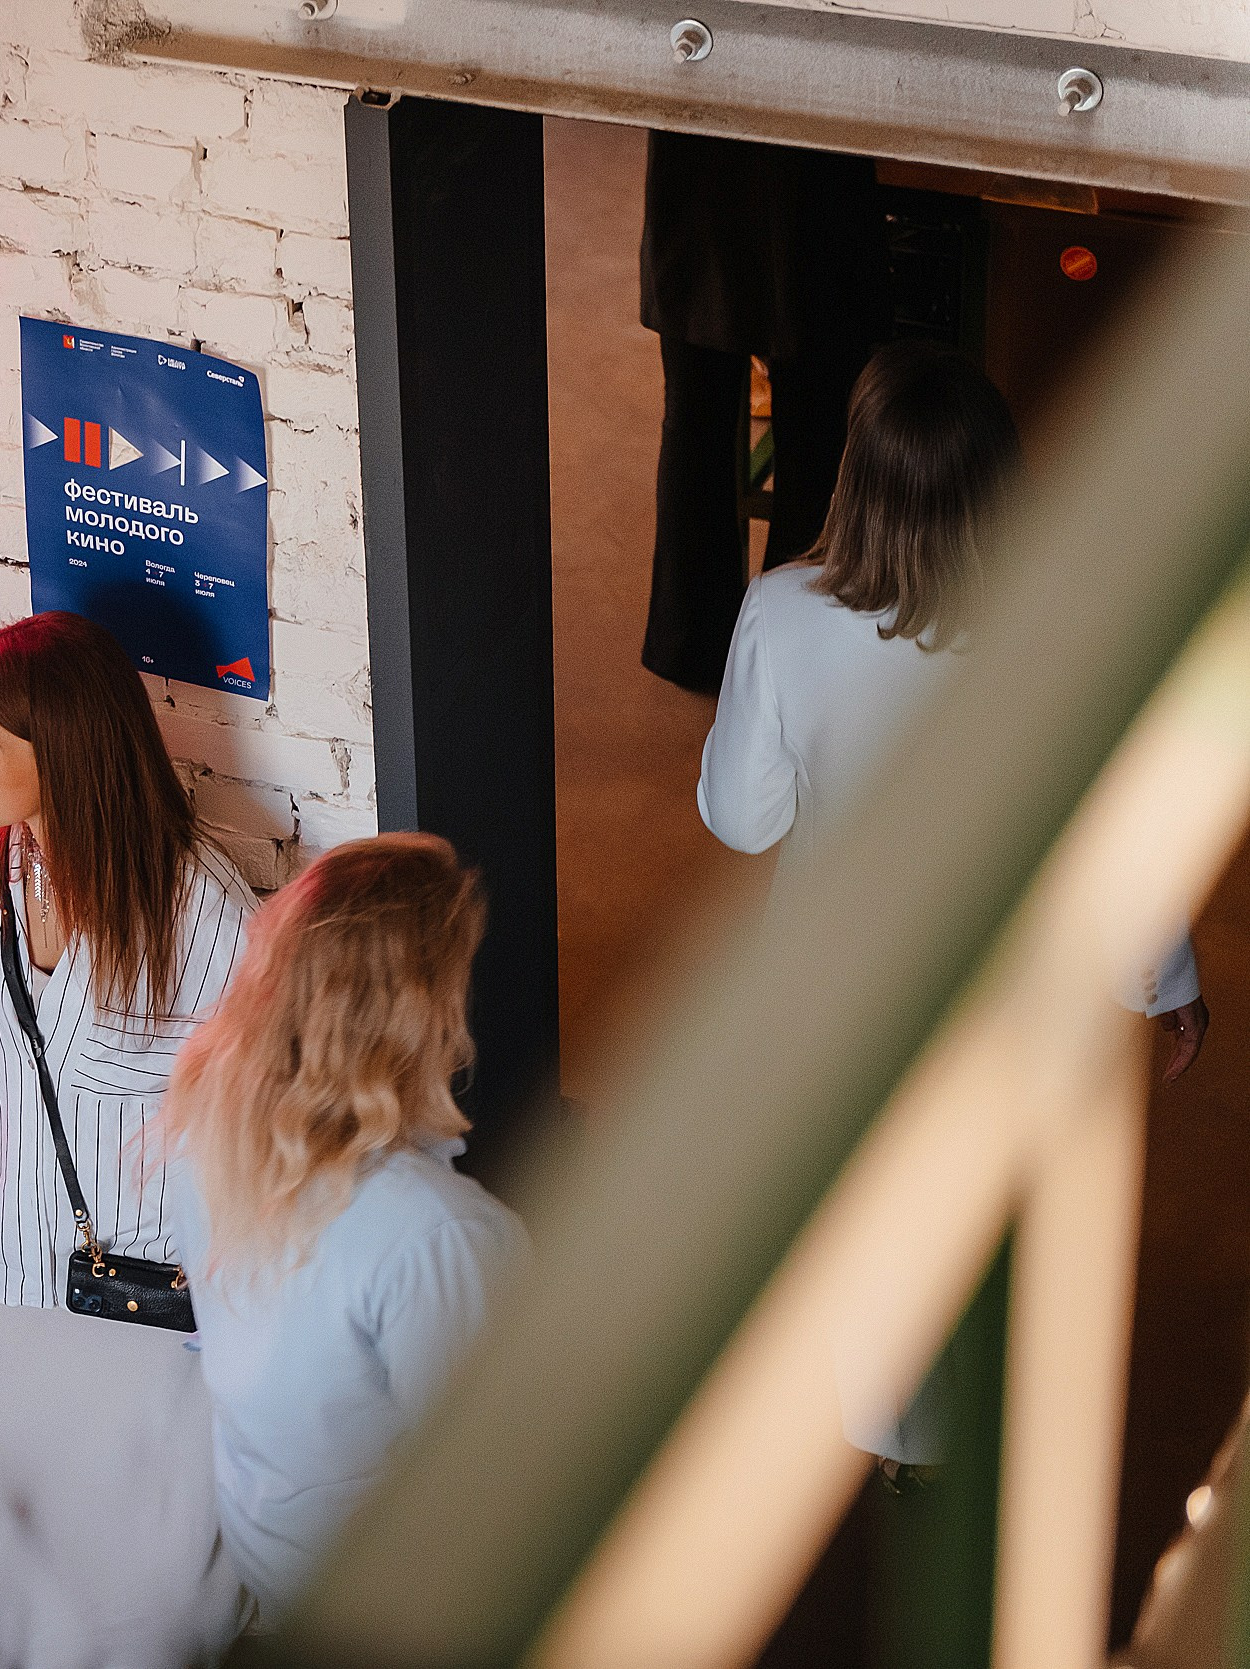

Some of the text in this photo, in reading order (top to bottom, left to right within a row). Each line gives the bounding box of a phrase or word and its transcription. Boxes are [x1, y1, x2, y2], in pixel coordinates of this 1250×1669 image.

[207, 370, 244, 387] Северсталь
[64, 478, 199, 524] фестиваль
[65, 505, 184, 546] молодого
[66, 529, 125, 556] кино
[69, 558, 88, 568] 2024
[145, 559, 176, 574] Вологда
[145, 577, 165, 587] июля
[194, 571, 235, 588] Череповец
[208, 582, 214, 590] 7
[195, 588, 215, 598] июля
[222, 676, 252, 690] VOICES
